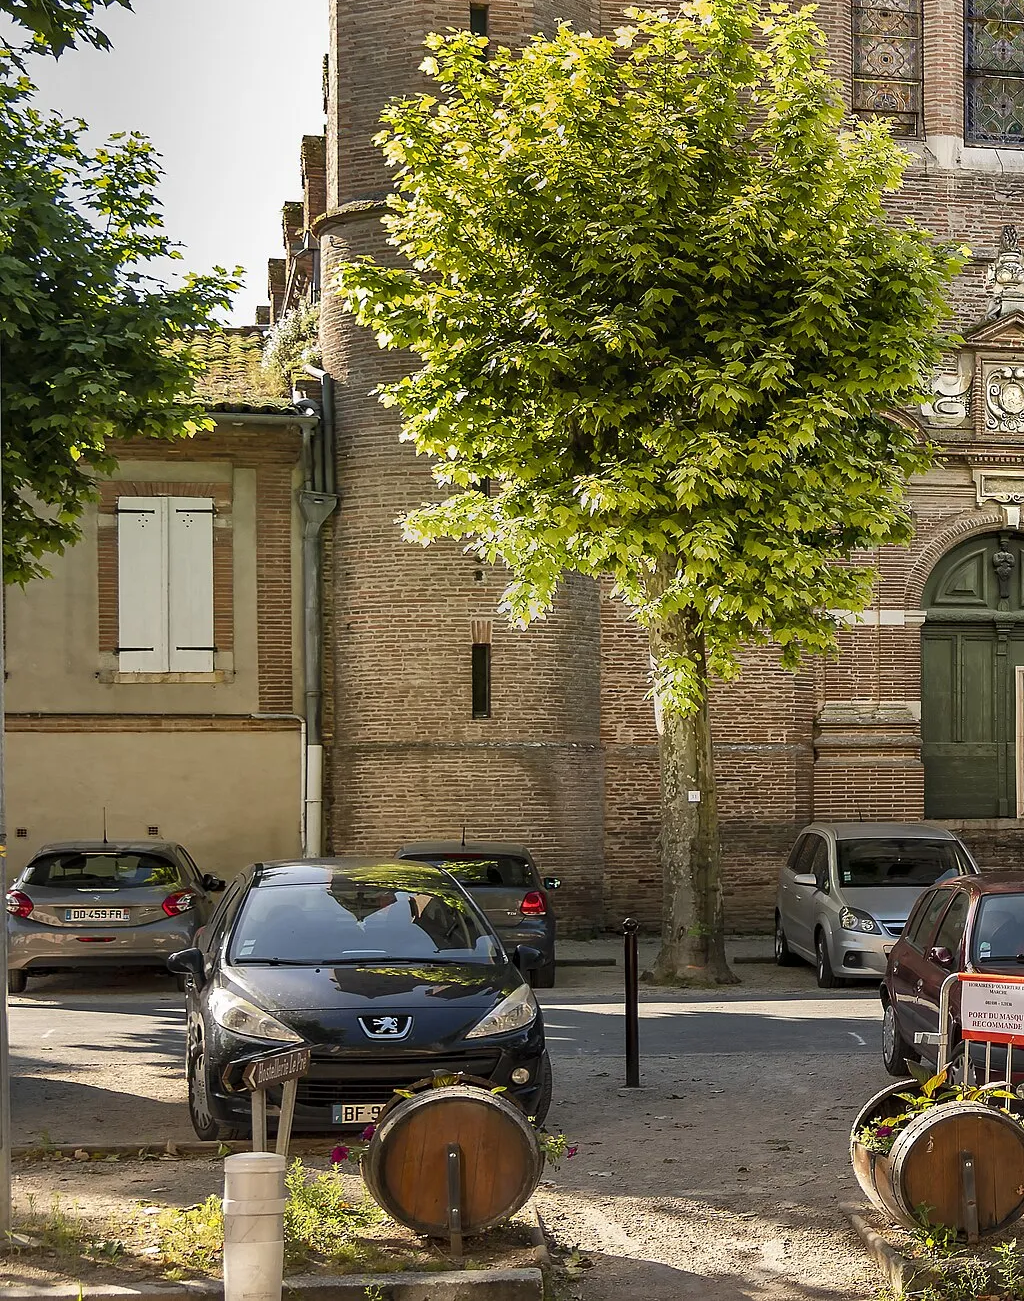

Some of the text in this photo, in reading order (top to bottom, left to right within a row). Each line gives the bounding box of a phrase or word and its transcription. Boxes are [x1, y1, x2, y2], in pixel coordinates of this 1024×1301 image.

[73, 910, 122, 919] DD-459-FR
[968, 1011, 988, 1019] PORT
[988, 1012, 999, 1020] DU
[972, 1020, 1023, 1030] RECOMMANDE
